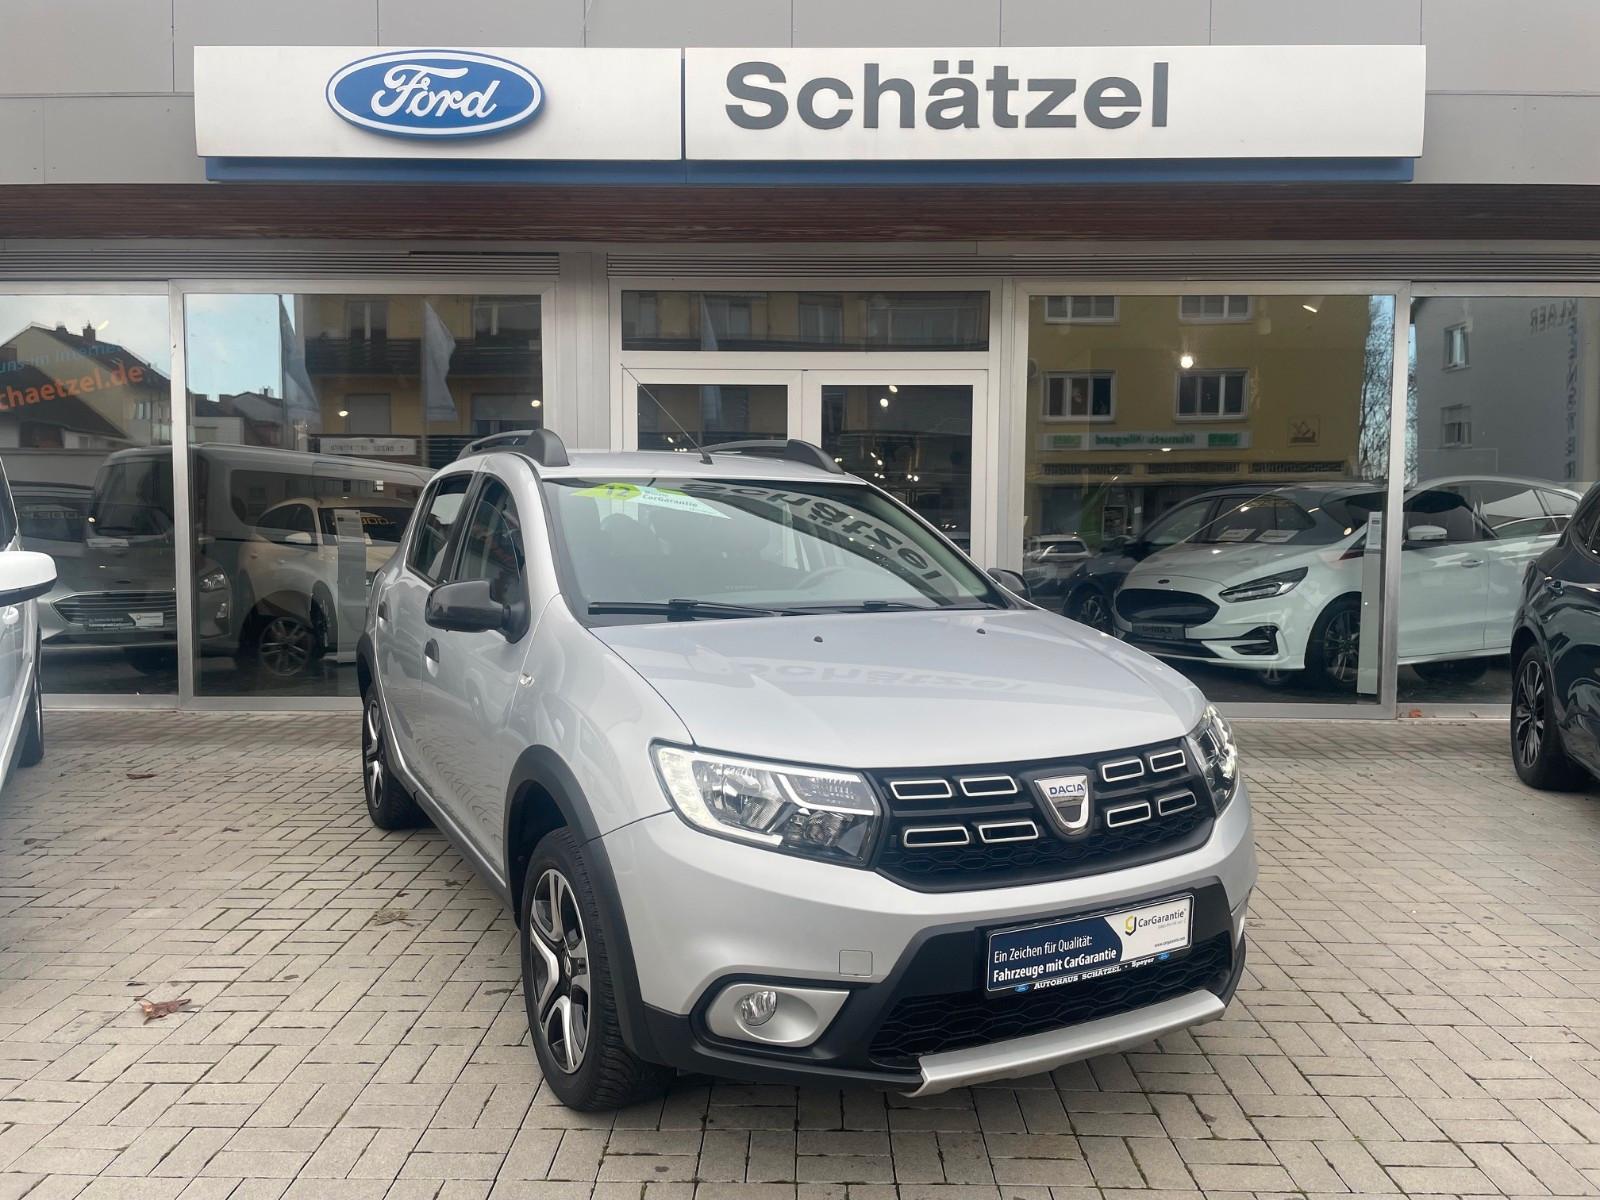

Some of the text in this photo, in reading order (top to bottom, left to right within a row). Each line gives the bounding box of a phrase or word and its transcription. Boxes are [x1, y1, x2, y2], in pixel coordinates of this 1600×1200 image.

[371, 64, 500, 117] Ford
[725, 60, 1169, 130] Schätzel
[1049, 783, 1084, 795] DACIA
[993, 947, 1117, 983] Fahrzeuge mit CarGarantie
[994, 935, 1093, 964] Ein Zeichen für Qualität:
[1033, 975, 1079, 990] AUTOHAUS
